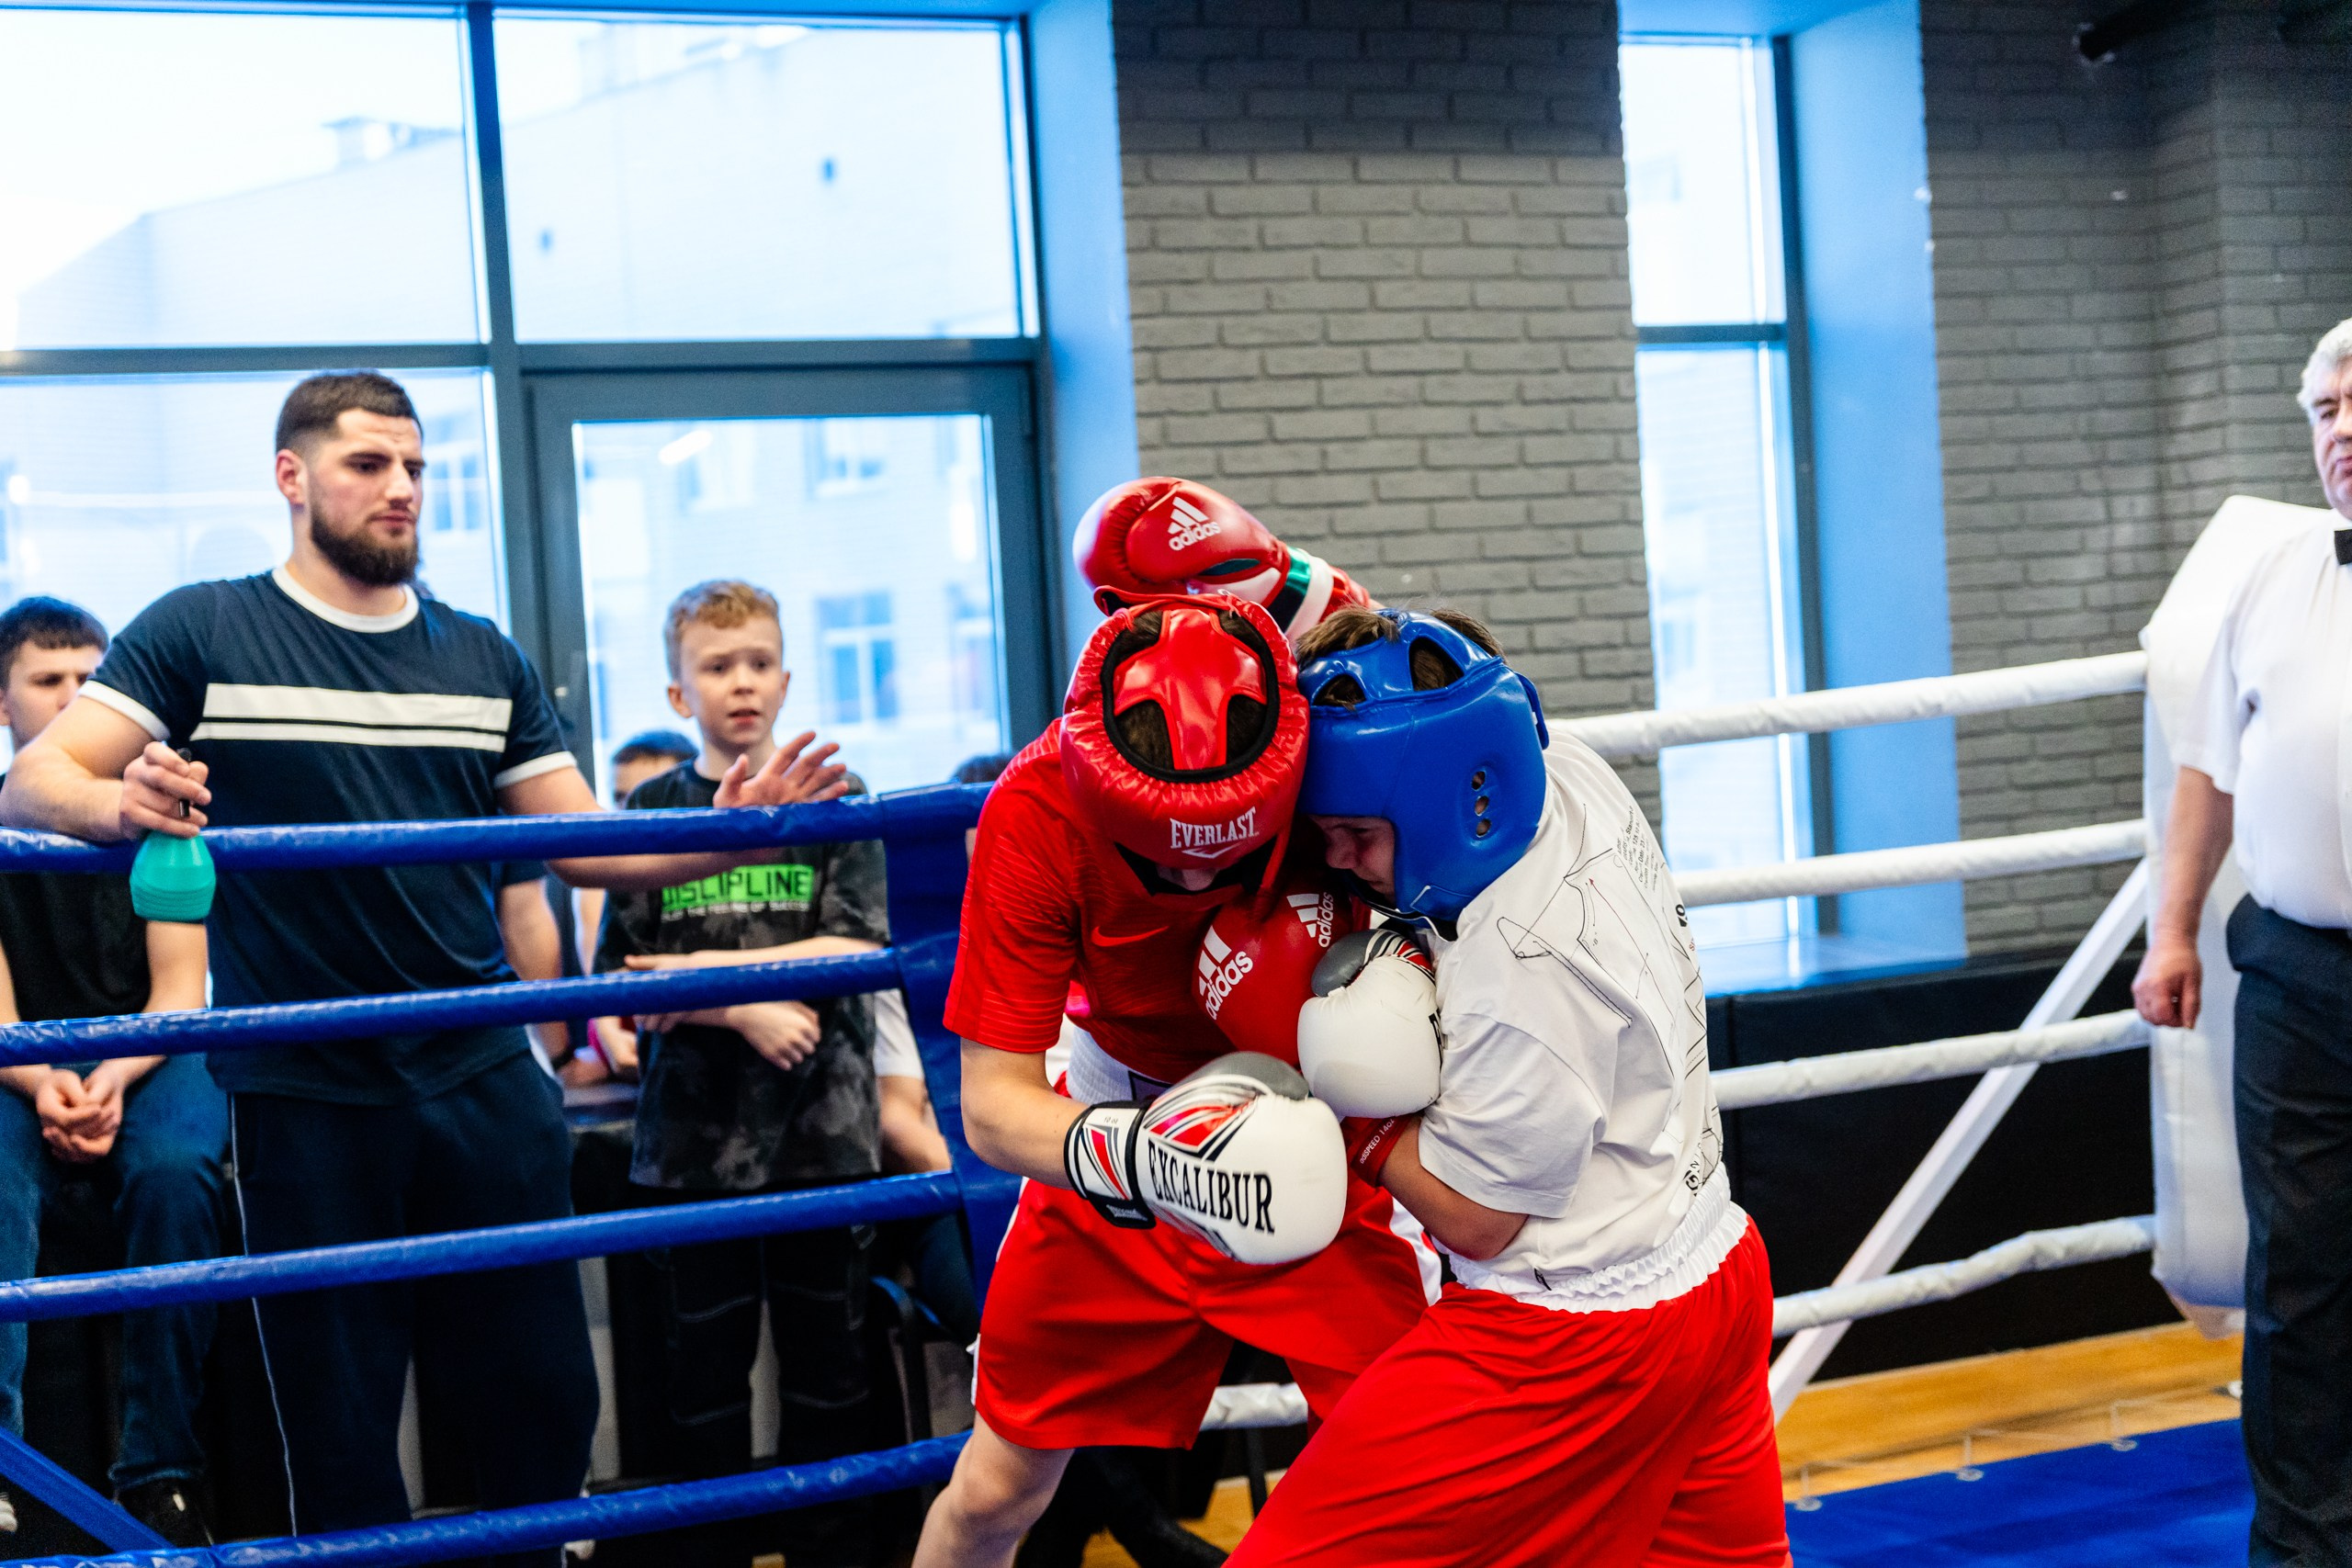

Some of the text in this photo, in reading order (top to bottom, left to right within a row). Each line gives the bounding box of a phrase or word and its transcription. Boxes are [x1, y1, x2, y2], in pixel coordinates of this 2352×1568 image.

[1169, 522, 1220, 550] adidas
[1170, 807, 1260, 849] EVERLAST
[1317, 892, 1334, 948] adidas
[1205, 951, 1253, 1021] adidas
[1360, 1135, 1381, 1164] adiSPEED
[1148, 1136, 1275, 1234] EXCALIBUR
